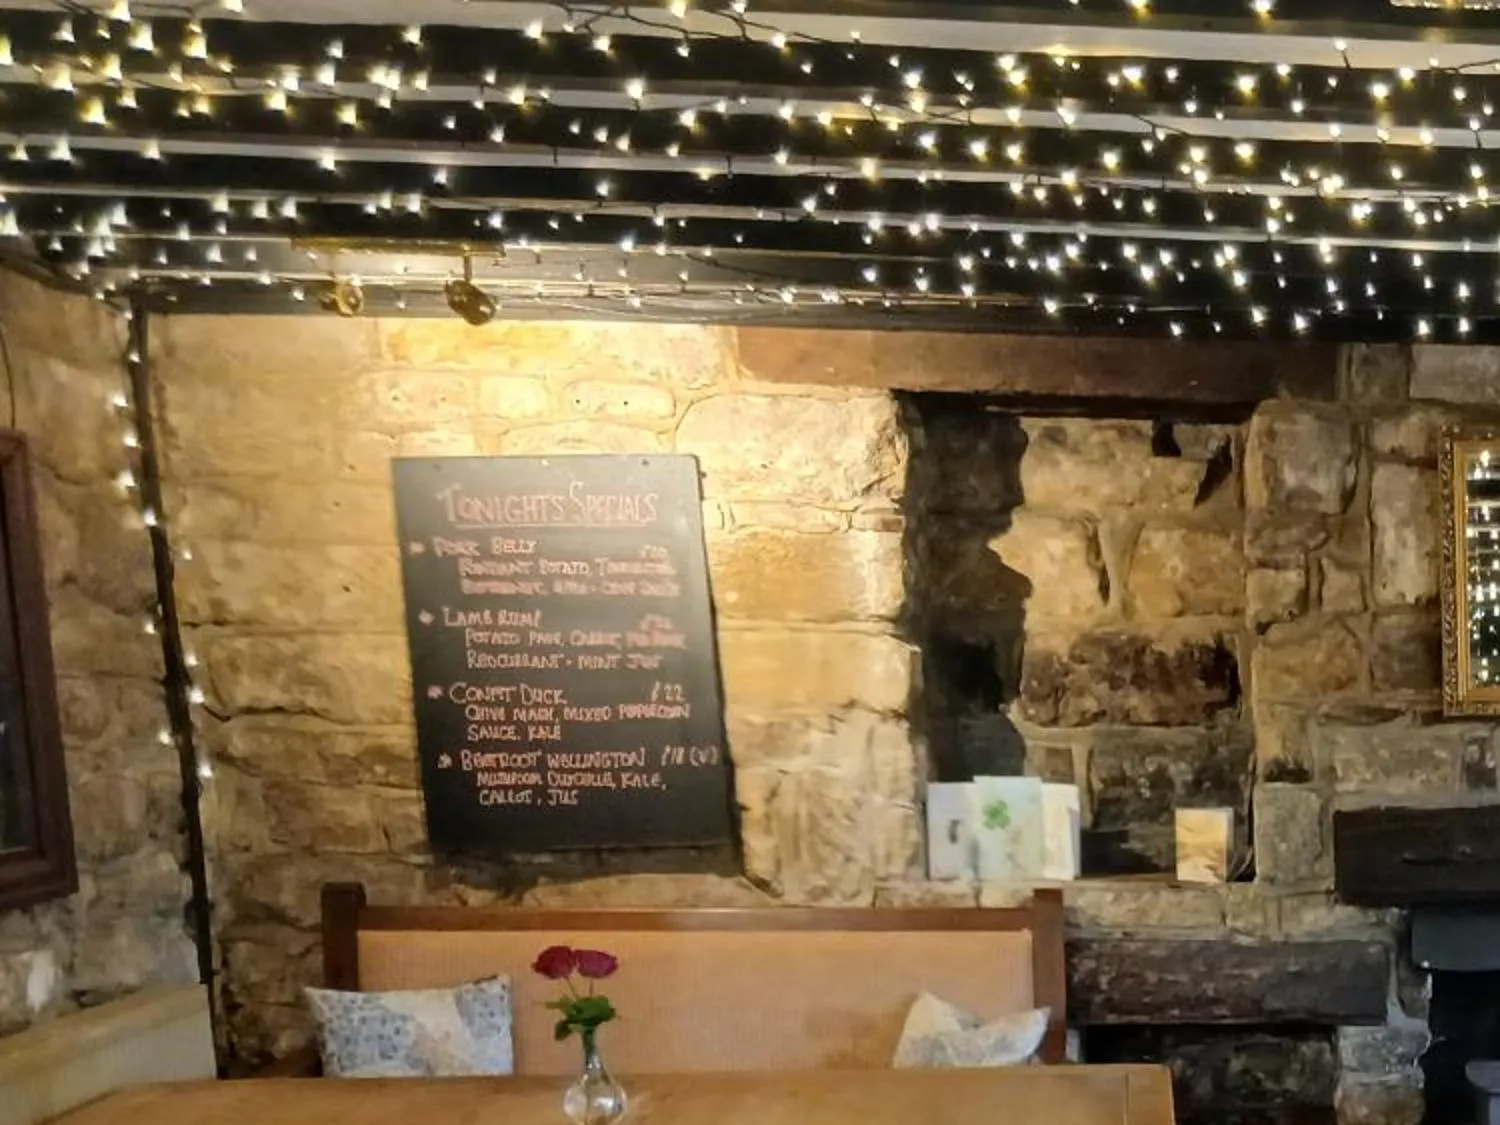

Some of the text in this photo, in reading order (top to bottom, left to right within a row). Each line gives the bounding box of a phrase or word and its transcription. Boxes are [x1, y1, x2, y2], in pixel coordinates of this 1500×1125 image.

[569, 480, 658, 526] SPECIALS
[491, 536, 536, 555] BELLY
[442, 606, 541, 627] LAMB RUMP
[466, 628, 520, 648] POTATO
[449, 681, 568, 705] CONFIT DUCK
[563, 706, 612, 721] MIXED
[527, 725, 561, 742] KALE
[461, 749, 541, 771] BEETROOT
